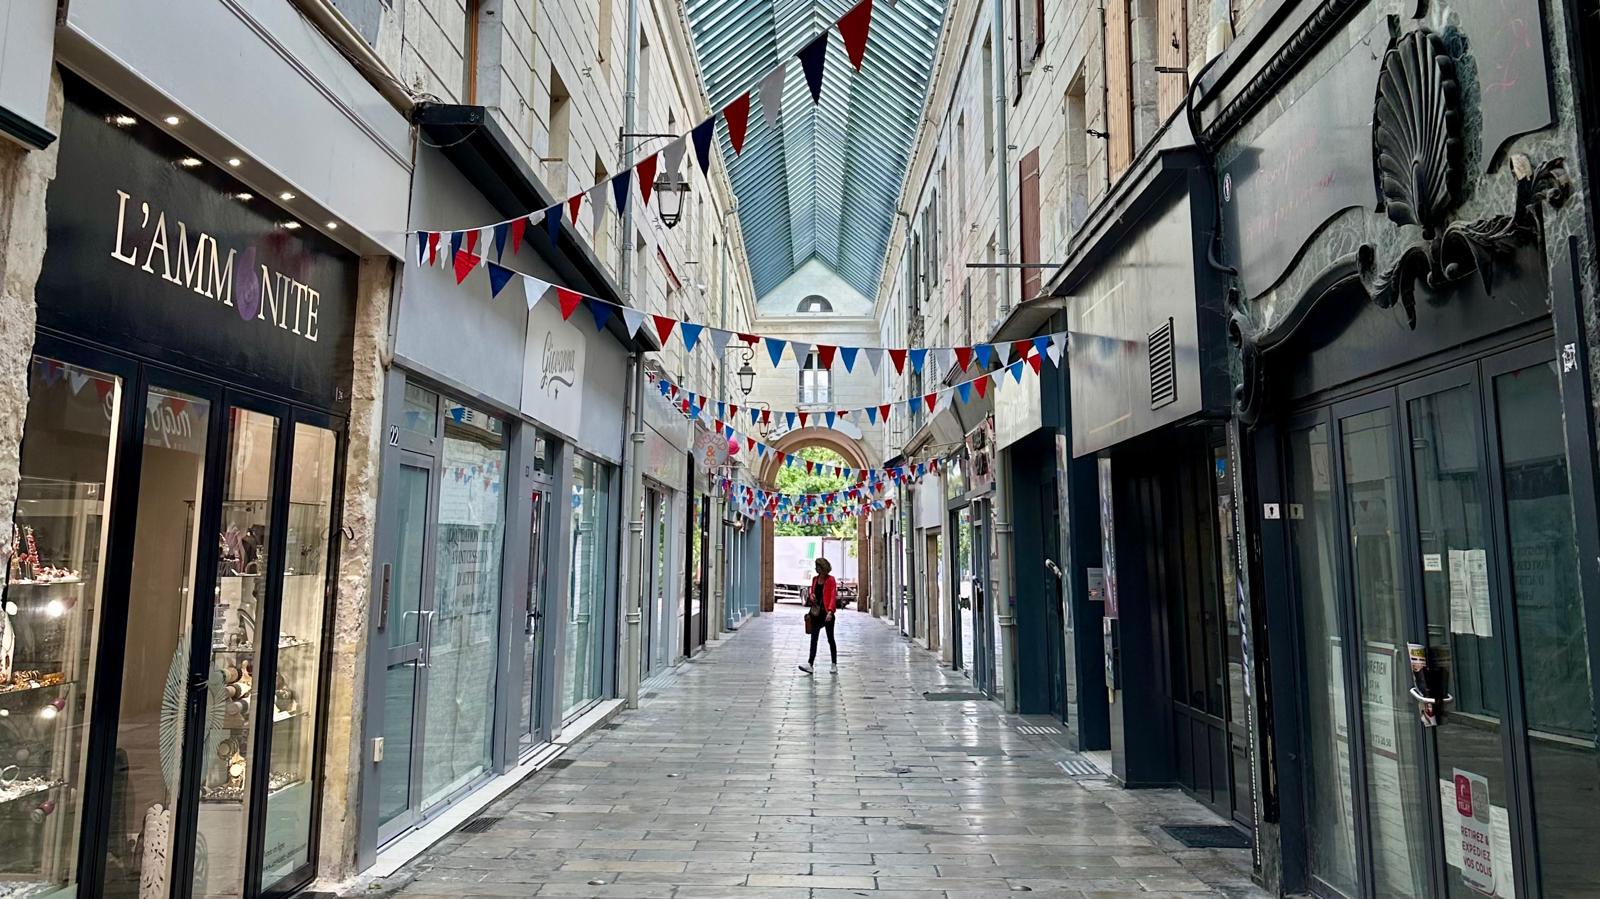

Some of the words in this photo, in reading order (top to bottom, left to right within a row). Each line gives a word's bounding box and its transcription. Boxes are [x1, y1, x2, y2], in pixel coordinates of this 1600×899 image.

[390, 425, 399, 447] 22
[1461, 825, 1484, 844] RETIREZ
[1463, 856, 1475, 870] VOS
[1475, 861, 1493, 878] COLIS
